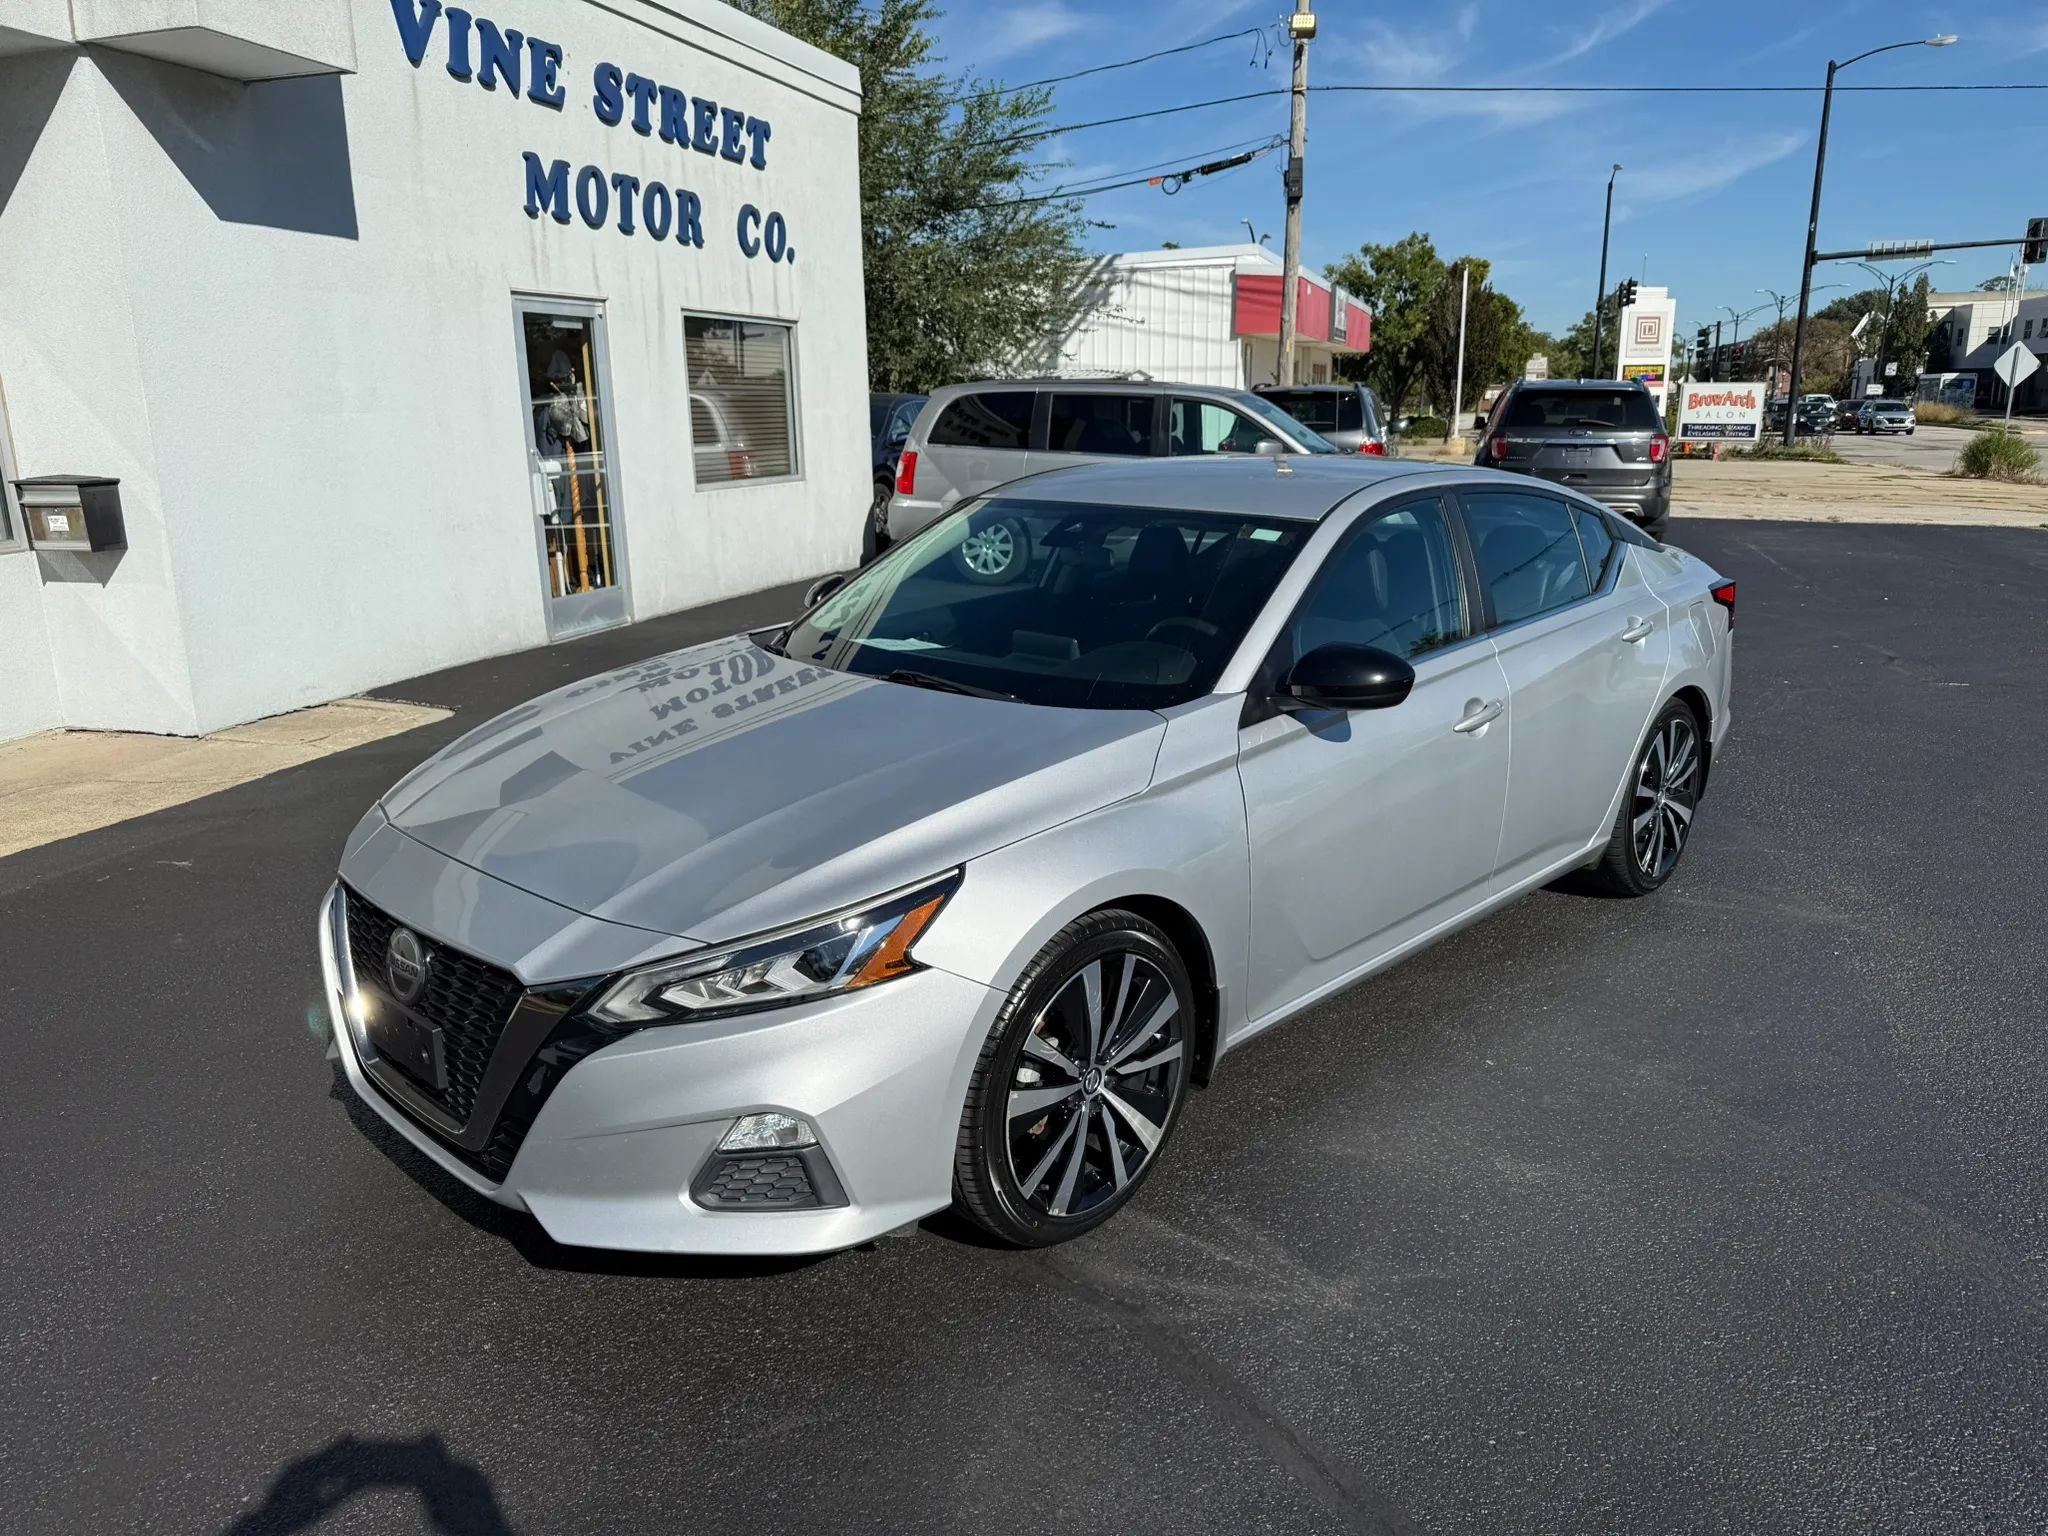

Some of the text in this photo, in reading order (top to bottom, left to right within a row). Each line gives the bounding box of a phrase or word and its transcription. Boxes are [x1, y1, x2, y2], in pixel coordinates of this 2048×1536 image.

[391, 0, 772, 172] VINE STREET
[522, 151, 796, 265] MOTOR CO.
[1696, 411, 1746, 419] SALON
